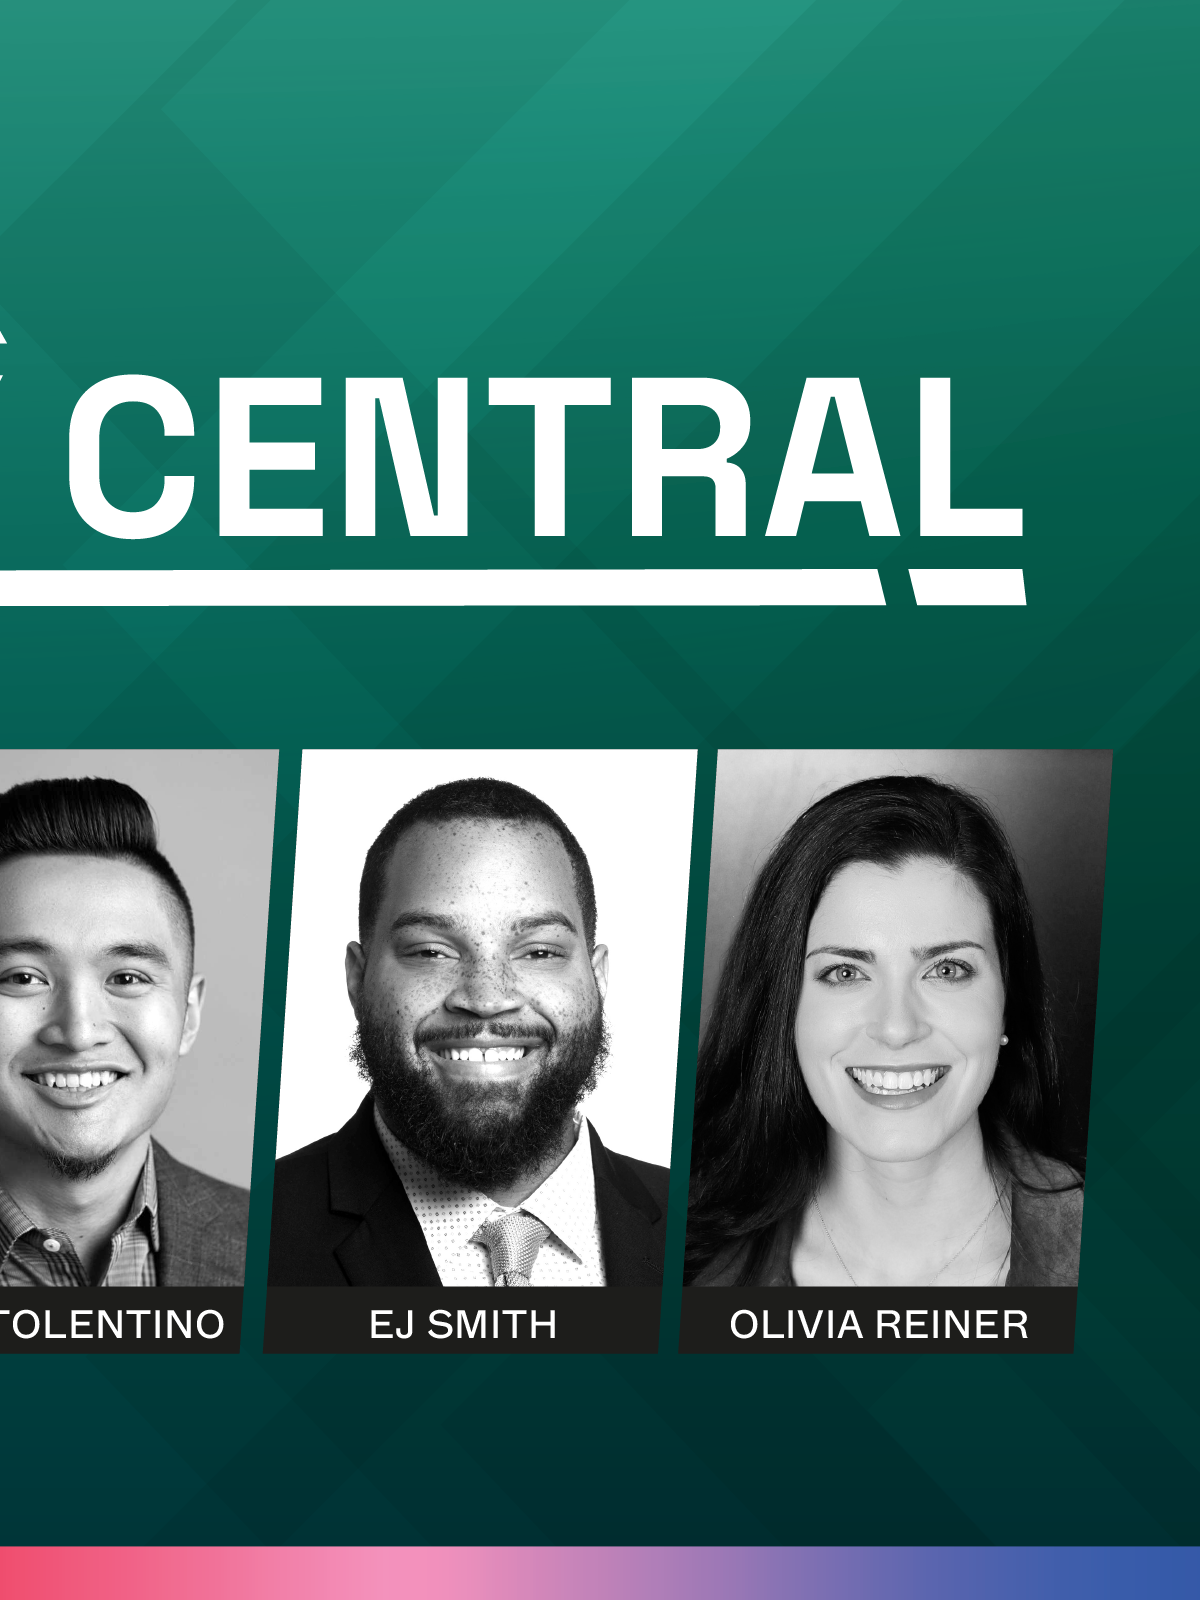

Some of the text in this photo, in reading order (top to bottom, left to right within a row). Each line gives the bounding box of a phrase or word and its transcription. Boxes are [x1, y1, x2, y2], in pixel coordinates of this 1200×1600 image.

[68, 373, 1024, 540] CENTRAL
[370, 1308, 557, 1340] EJ SMITH
[729, 1308, 1029, 1340] OLIVIA REINER
